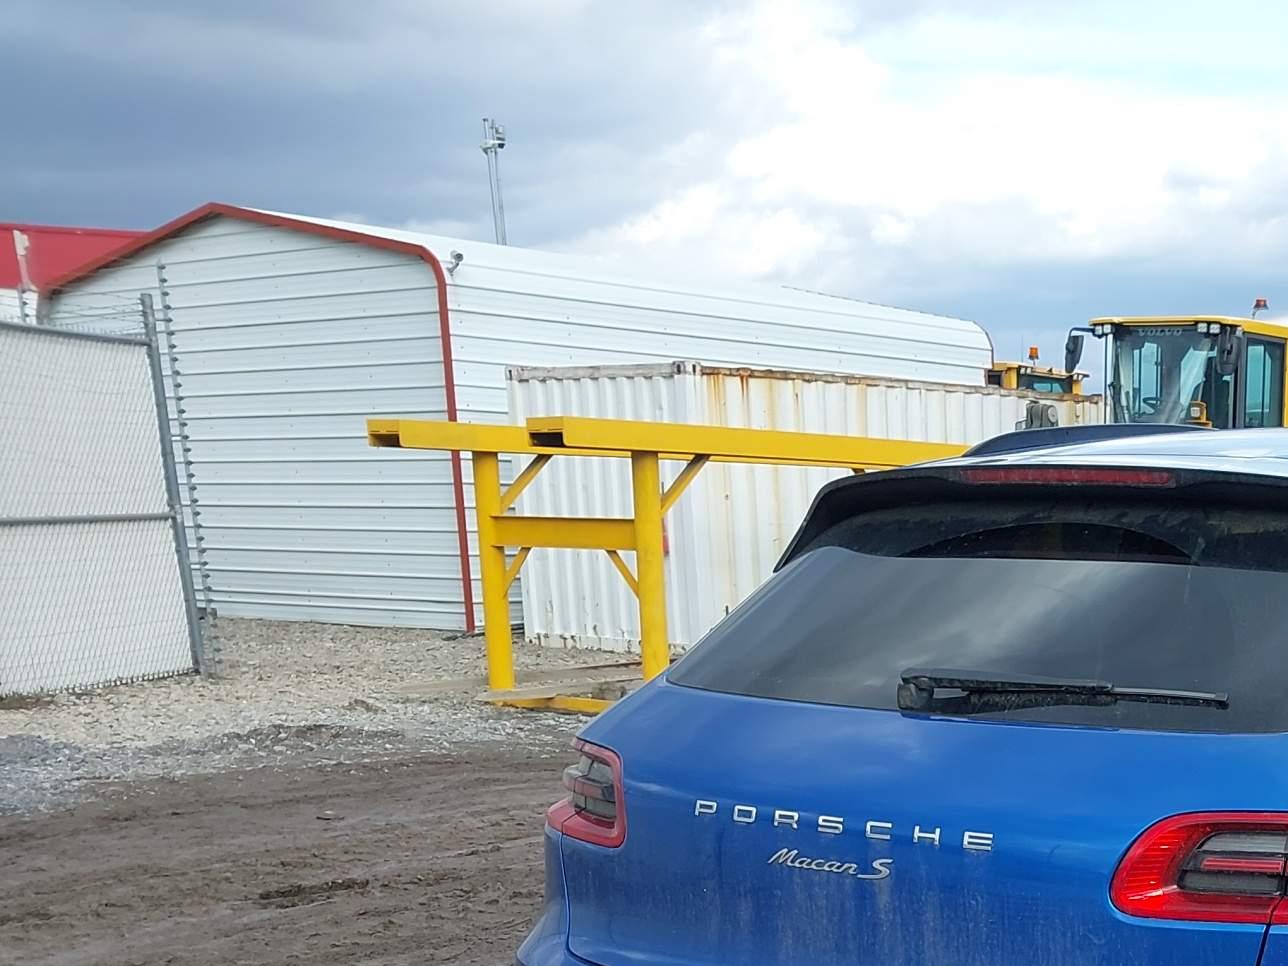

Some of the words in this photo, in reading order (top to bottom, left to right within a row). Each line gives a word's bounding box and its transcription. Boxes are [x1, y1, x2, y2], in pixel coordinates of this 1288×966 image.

[1137, 328, 1182, 337] VOLVO
[694, 799, 994, 851] PORSCHE
[767, 847, 859, 875] Macan
[857, 858, 894, 880] S
